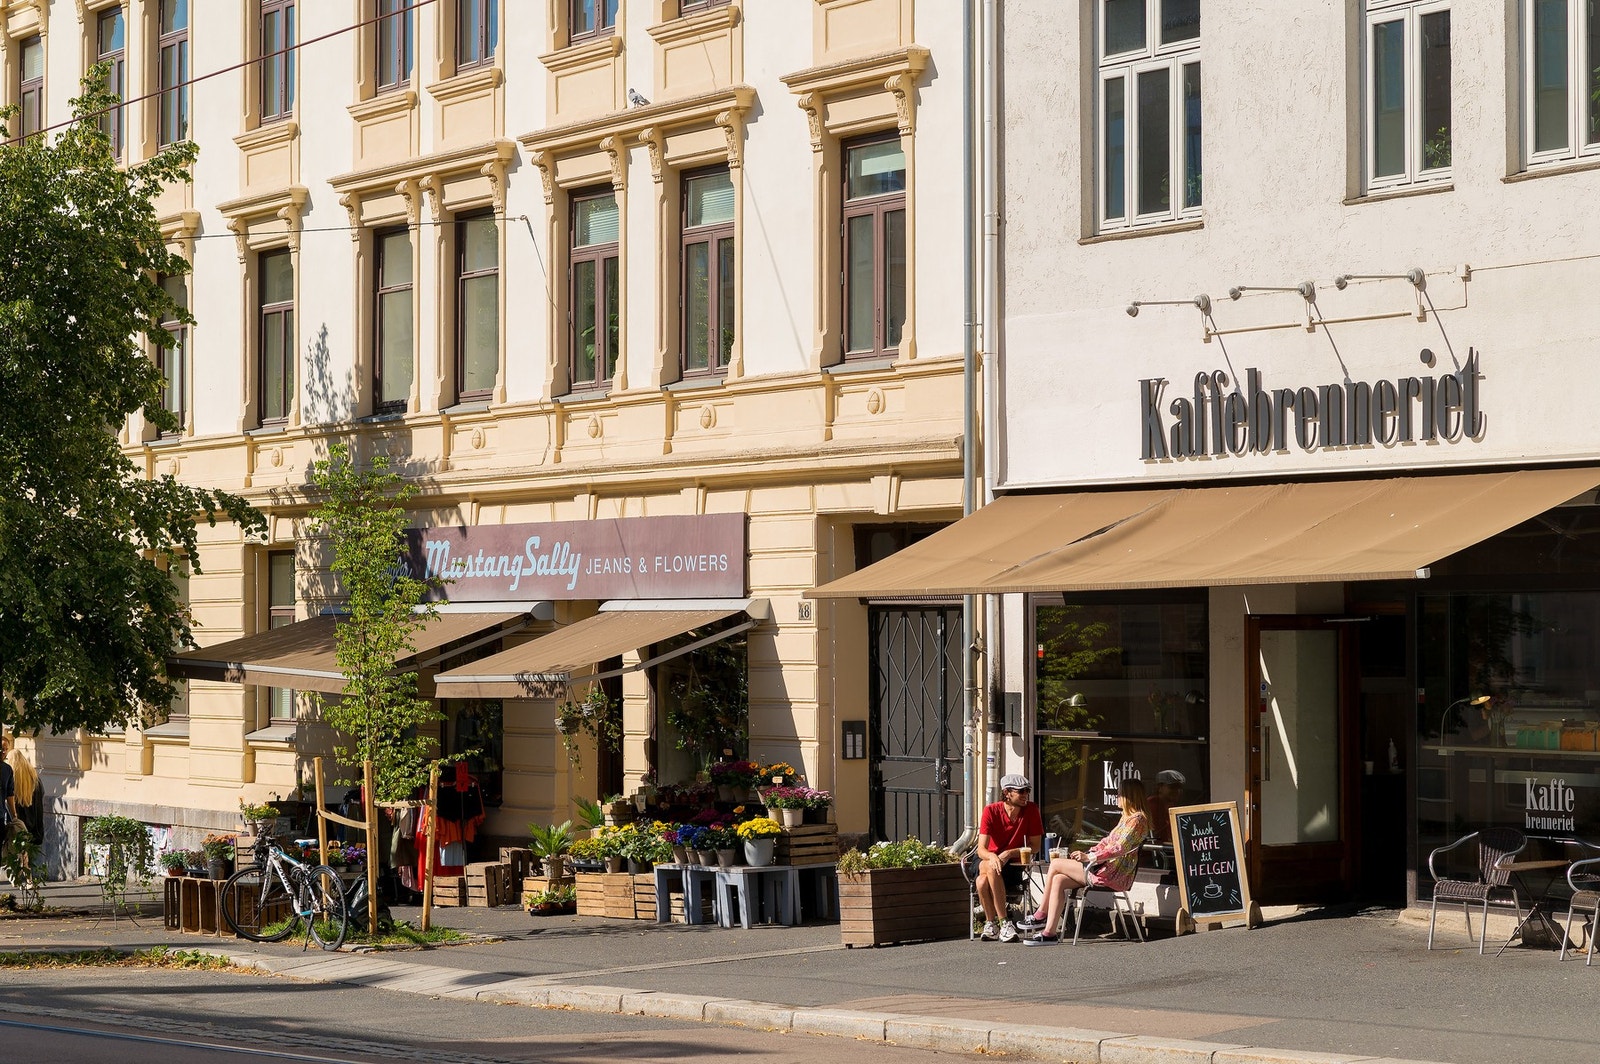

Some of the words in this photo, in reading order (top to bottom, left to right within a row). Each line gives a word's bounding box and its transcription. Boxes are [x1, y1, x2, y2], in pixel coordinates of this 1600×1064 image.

[1138, 346, 1483, 461] Kaffebrenneriet
[585, 557, 632, 575] JEANS
[638, 557, 648, 573] &
[654, 554, 728, 573] FLOWERS
[1525, 777, 1575, 812] Kaffe
[1525, 812, 1575, 832] brenneriet
[1191, 836, 1221, 852] KAFFE
[1200, 851, 1213, 862] til
[1189, 860, 1235, 877] HELGEN
